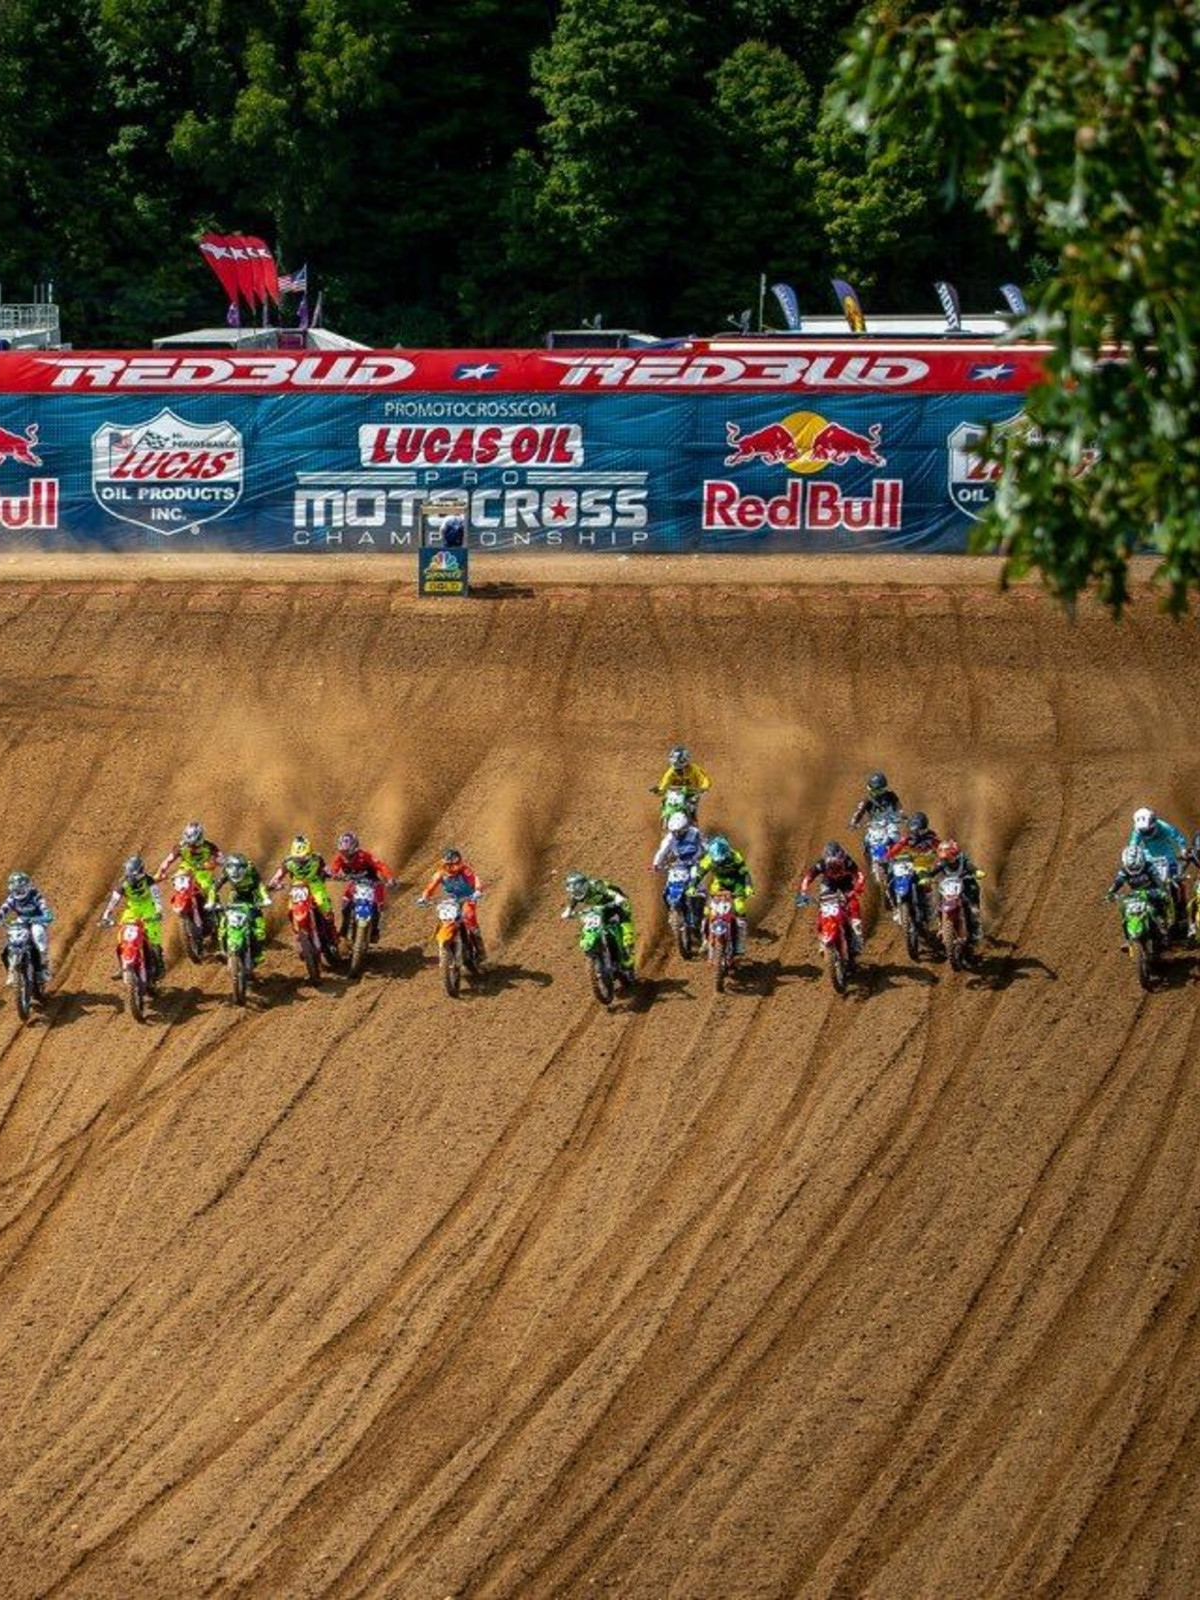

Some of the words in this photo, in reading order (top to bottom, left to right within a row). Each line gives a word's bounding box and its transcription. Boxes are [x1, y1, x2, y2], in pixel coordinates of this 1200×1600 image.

[34, 357, 417, 387] REDBUD
[539, 356, 930, 386] REDBUD
[384, 402, 557, 418] PROMOTOCROSS.COM
[370, 427, 502, 464] LUCAS
[509, 427, 574, 464] OIL
[110, 451, 236, 479] LUCAS
[424, 471, 521, 484] PRO
[101, 487, 132, 501] OIL
[138, 487, 236, 501] PRODUCTS
[702, 478, 801, 530] Red
[805, 478, 903, 531] Bull
[151, 507, 187, 521] INC.
[294, 530, 649, 545] CHAMPONSHIP
